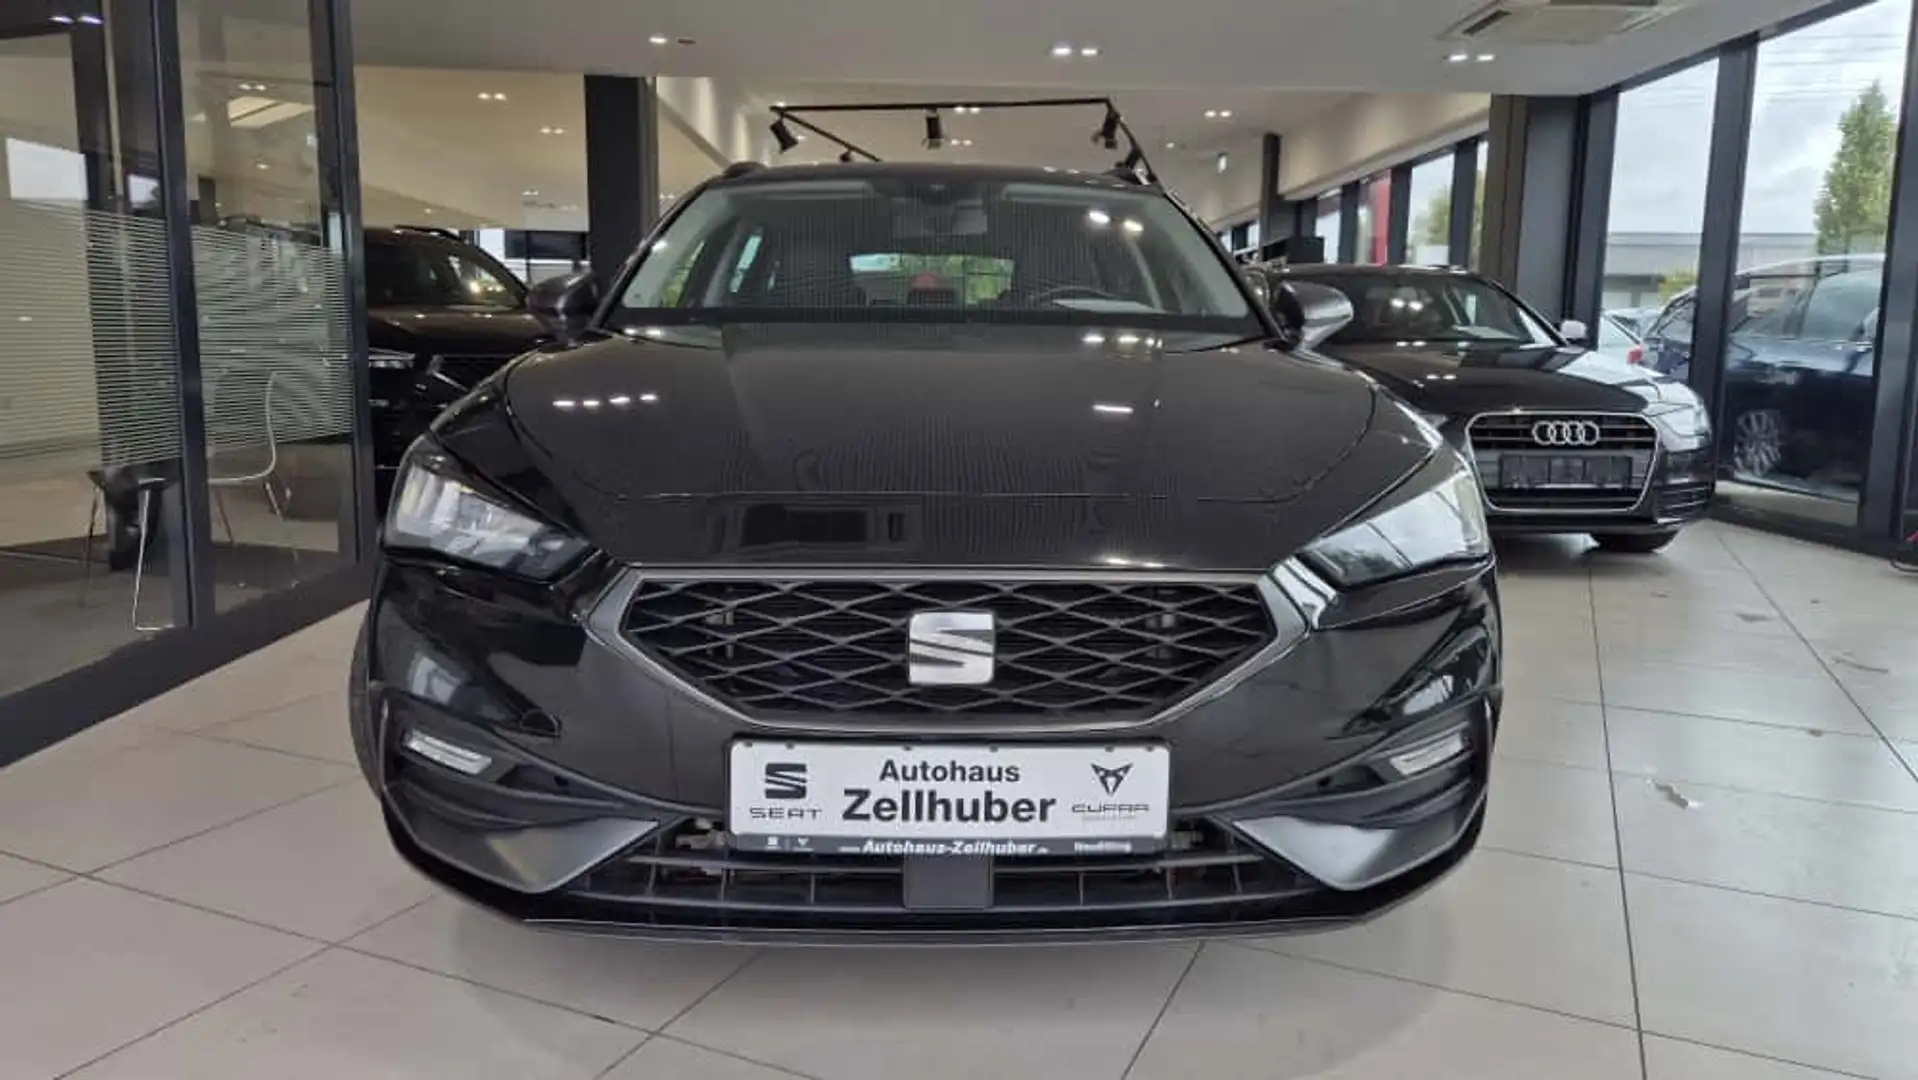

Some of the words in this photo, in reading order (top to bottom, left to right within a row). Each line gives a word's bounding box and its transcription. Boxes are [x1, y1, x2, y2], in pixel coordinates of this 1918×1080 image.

[878, 759, 1021, 782] Autohaus
[750, 806, 823, 819] SEAT
[842, 788, 1057, 823] Zellhuber
